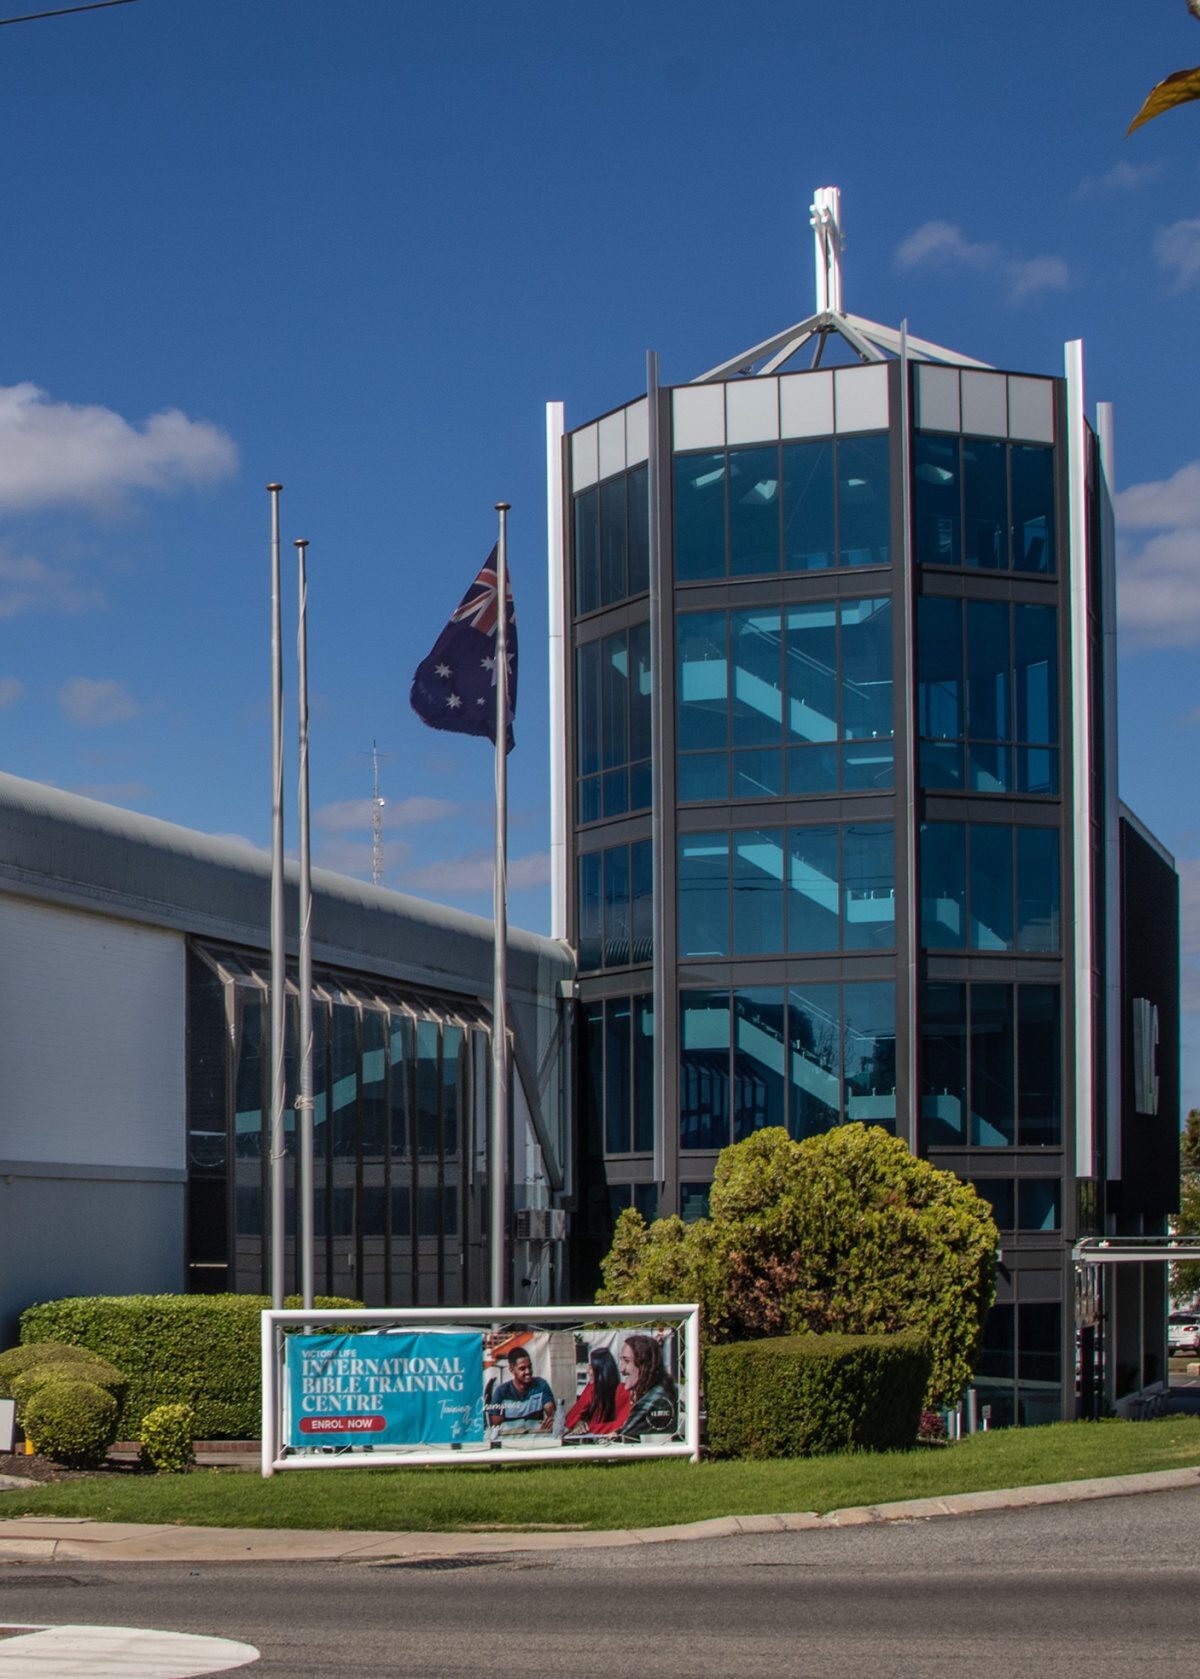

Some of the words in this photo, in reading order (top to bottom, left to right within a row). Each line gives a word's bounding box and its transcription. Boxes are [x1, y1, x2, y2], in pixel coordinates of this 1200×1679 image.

[302, 1350, 336, 1358] VICTORY
[339, 1349, 357, 1358] LIFE
[302, 1357, 465, 1376] INTERNATIONAL
[302, 1376, 361, 1394] BIBLE
[365, 1374, 464, 1393] TRAINING
[302, 1394, 384, 1412] CENTRE
[311, 1420, 344, 1429] ENROL
[348, 1419, 373, 1428] NOW
